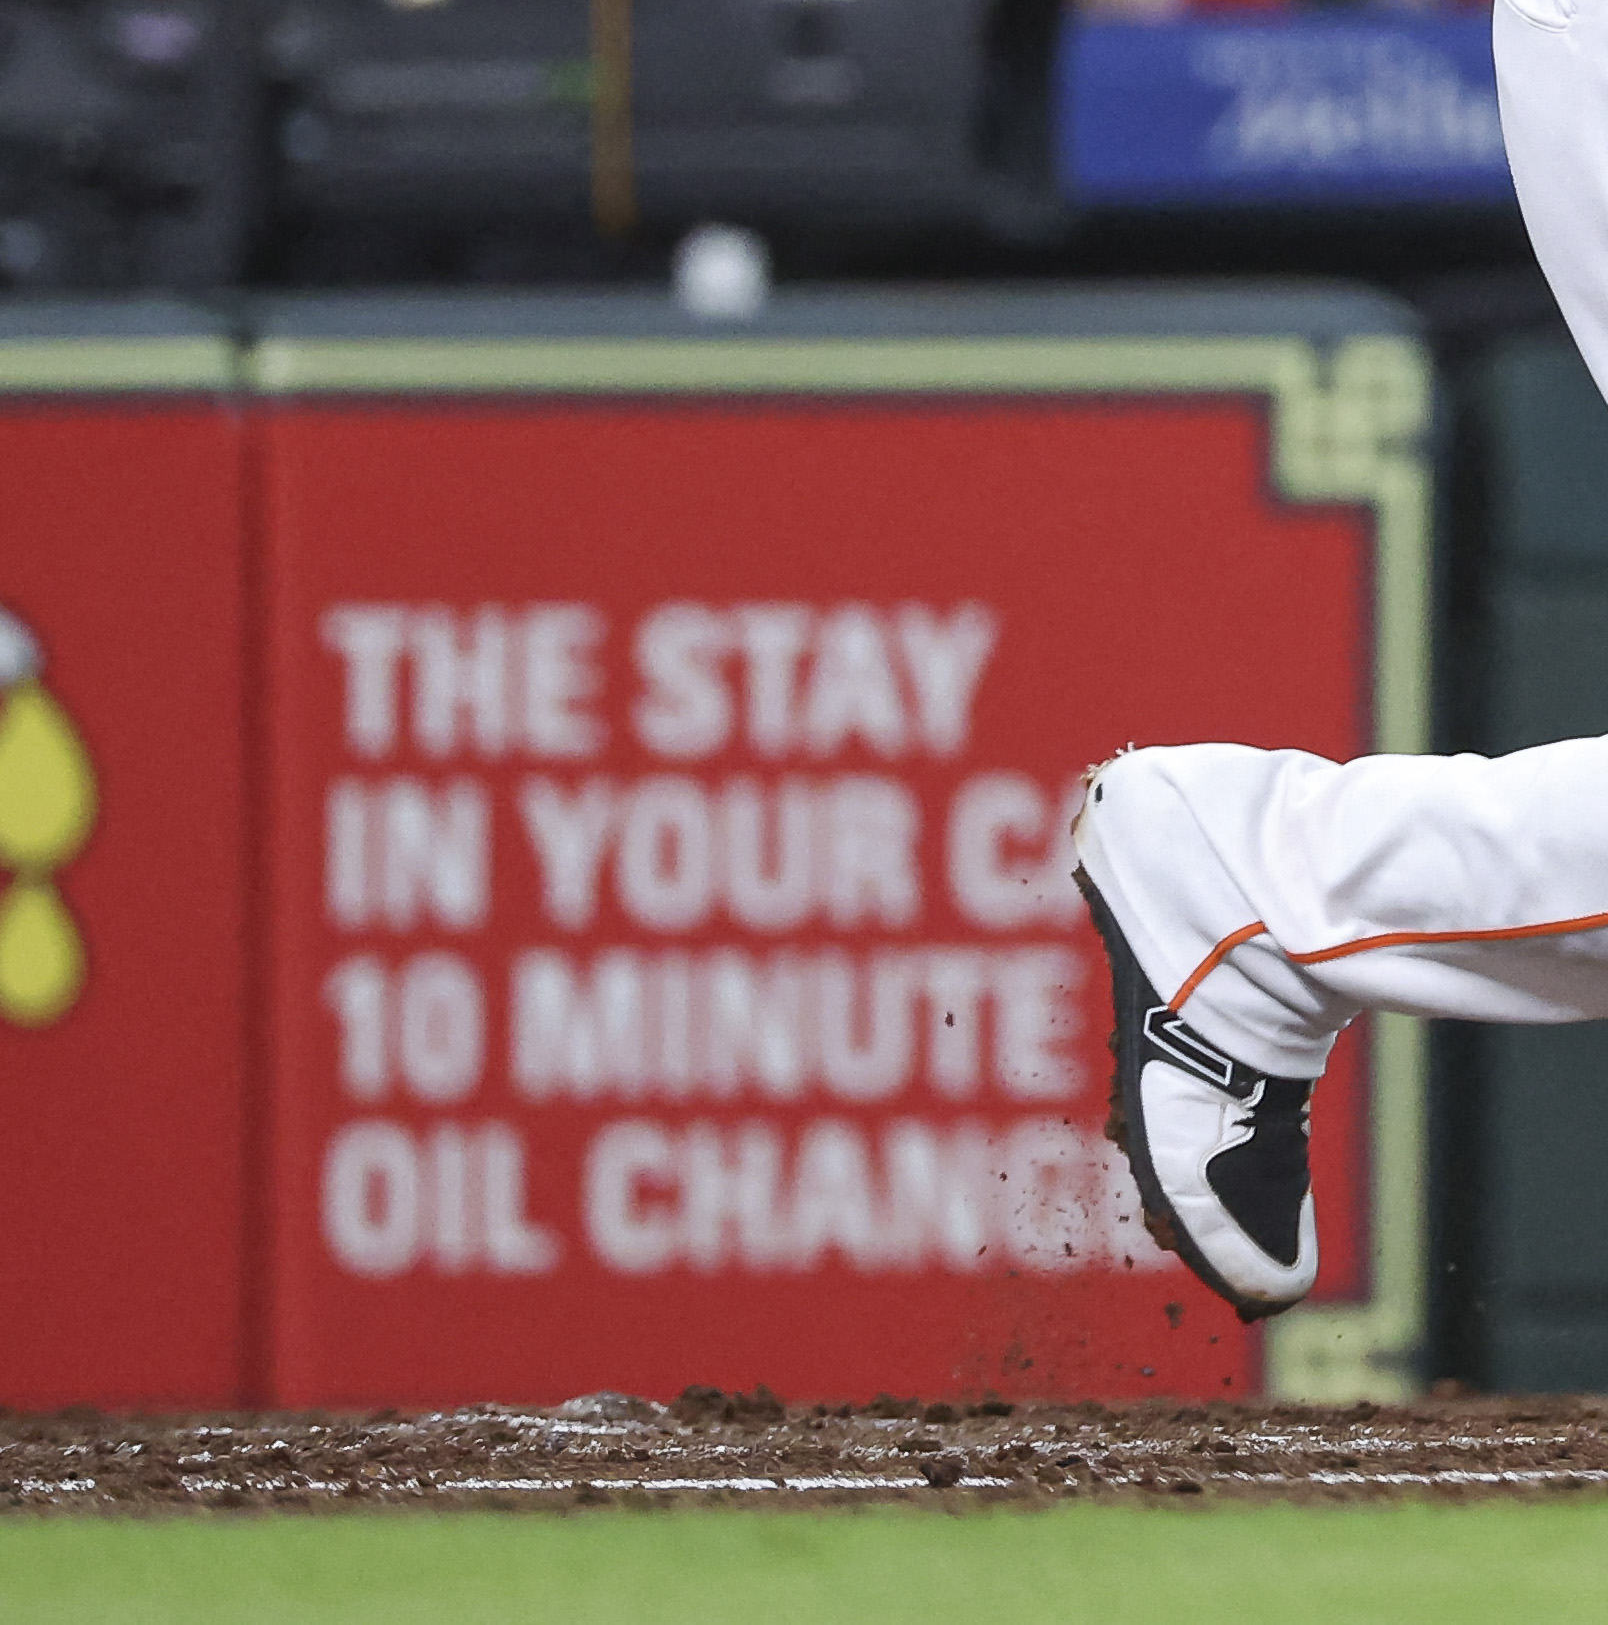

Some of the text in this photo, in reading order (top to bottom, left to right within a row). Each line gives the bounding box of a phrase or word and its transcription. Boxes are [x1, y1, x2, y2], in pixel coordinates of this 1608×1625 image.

[324, 604, 996, 757] THE STAY
[325, 782, 487, 926] IN
[525, 782, 918, 928] YOUR
[328, 948, 1085, 1098] 10 MINUTE
[325, 1120, 552, 1272] OIL
